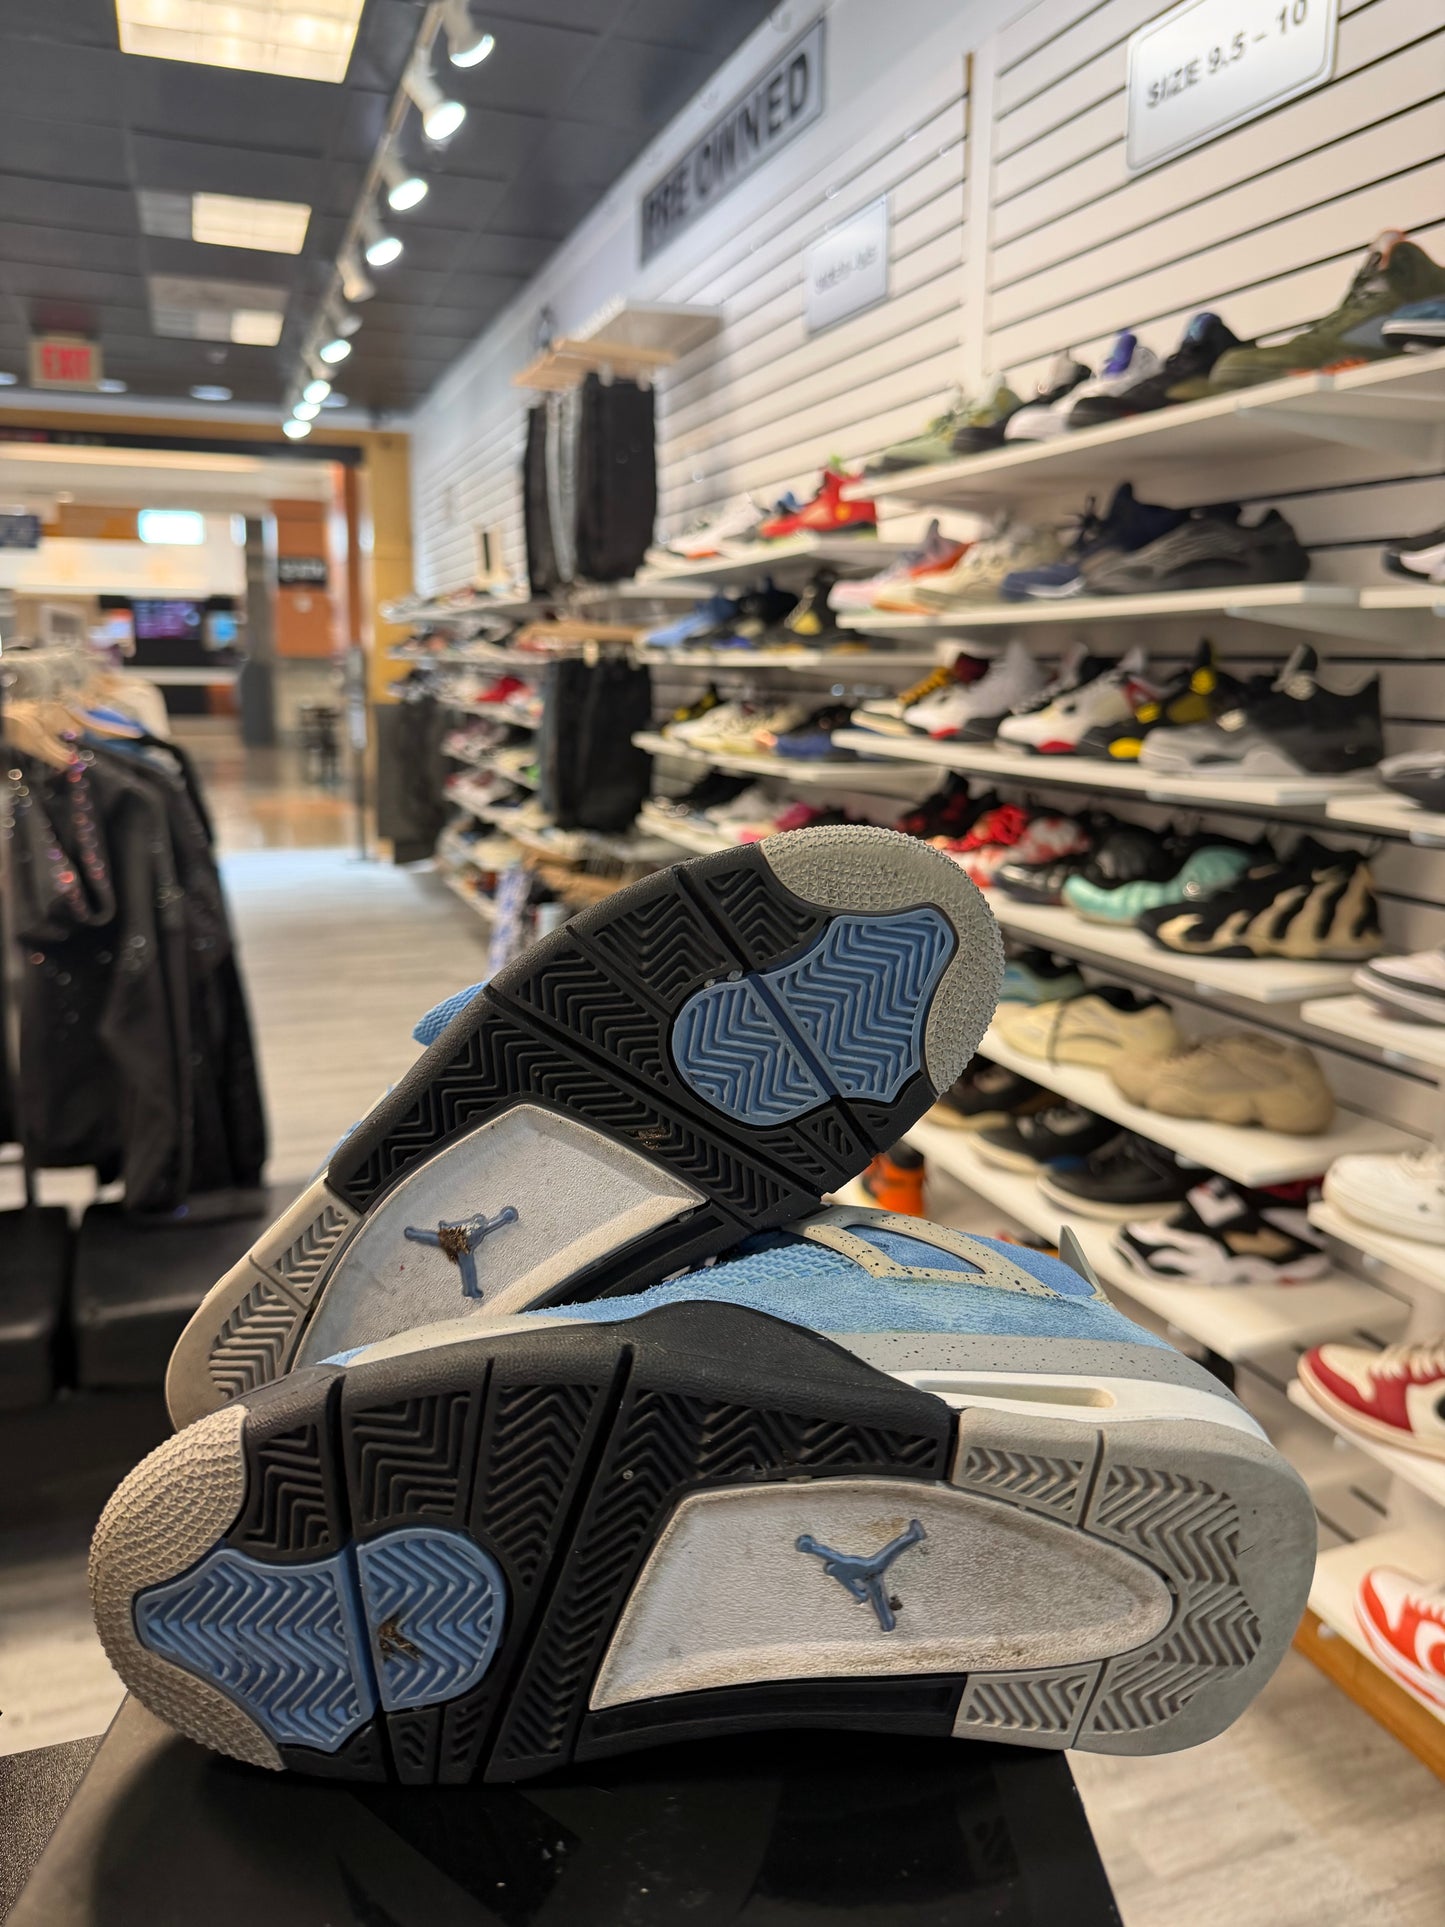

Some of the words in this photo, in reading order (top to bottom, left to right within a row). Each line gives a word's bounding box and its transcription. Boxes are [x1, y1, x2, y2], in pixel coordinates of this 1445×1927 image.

[1147, 58, 1201, 109] SIZE
[1207, 31, 1247, 75] 9.5
[1275, 0, 1308, 34] 10
[695, 52, 809, 201] OWNED
[42, 344, 91, 380] EXIT
